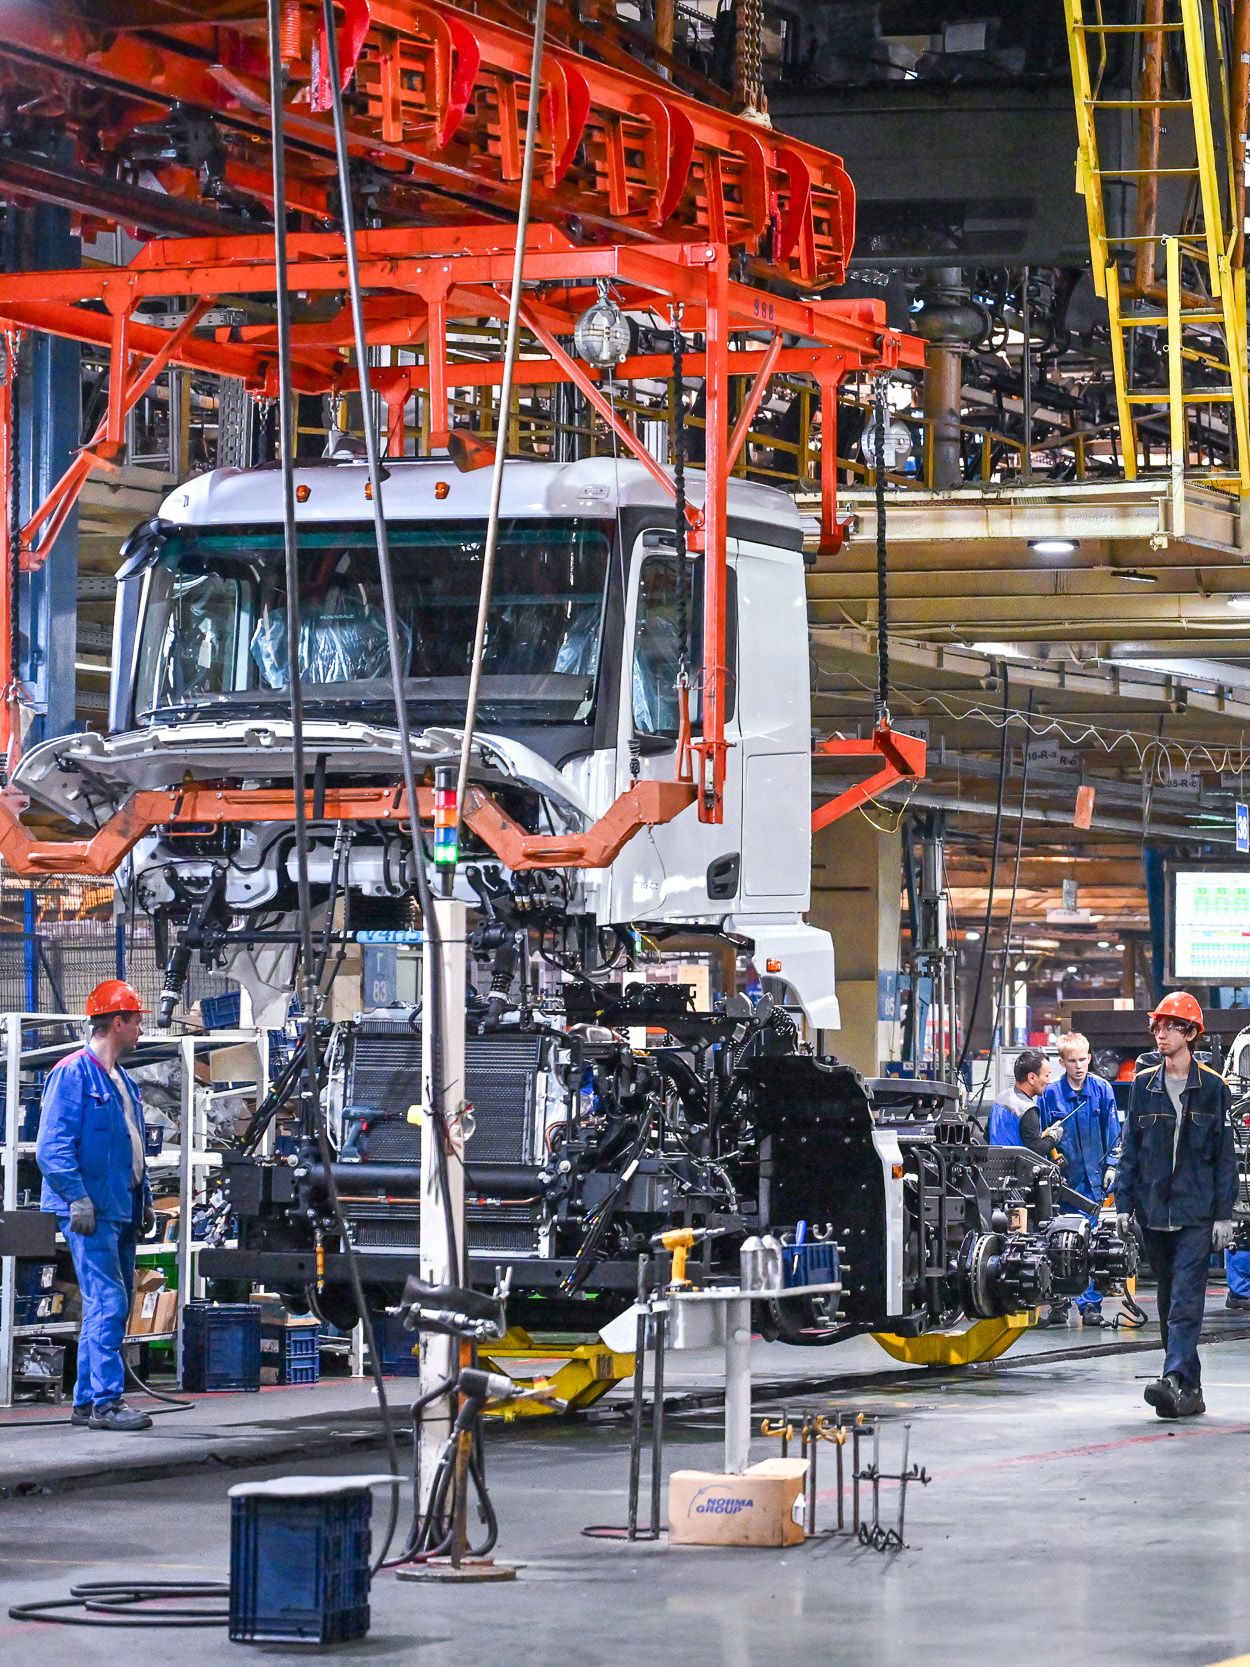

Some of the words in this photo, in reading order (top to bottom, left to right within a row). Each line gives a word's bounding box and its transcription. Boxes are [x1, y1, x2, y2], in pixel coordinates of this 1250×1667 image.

[373, 980, 387, 1003] 83
[707, 1498, 754, 1508] NORMA
[695, 1504, 743, 1514] GROUP
